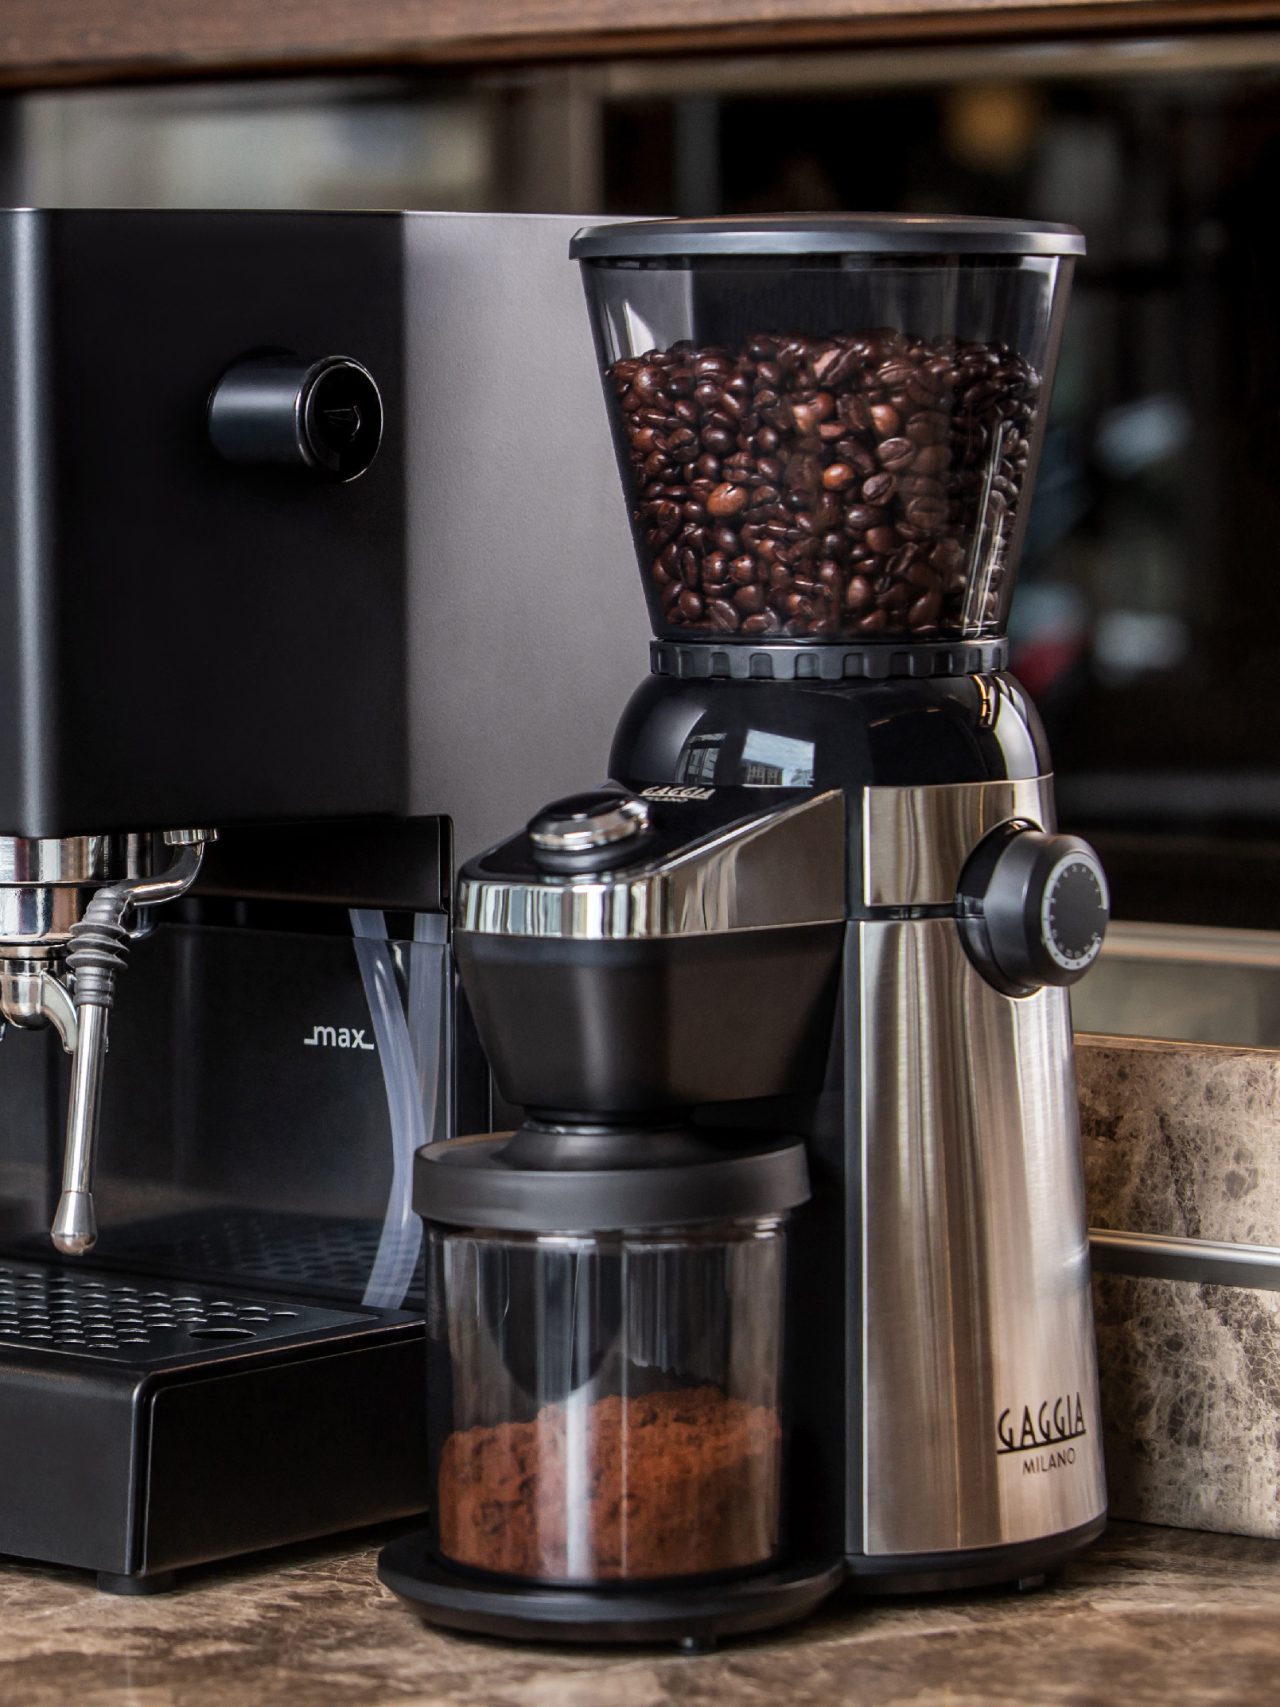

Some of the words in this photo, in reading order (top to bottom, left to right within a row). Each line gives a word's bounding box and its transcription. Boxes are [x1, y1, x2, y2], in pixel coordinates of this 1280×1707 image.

[638, 786, 716, 800] GAGGIA
[312, 1025, 367, 1049] max
[996, 1391, 1086, 1455] GAGGIA
[1022, 1447, 1076, 1475] MILANO
